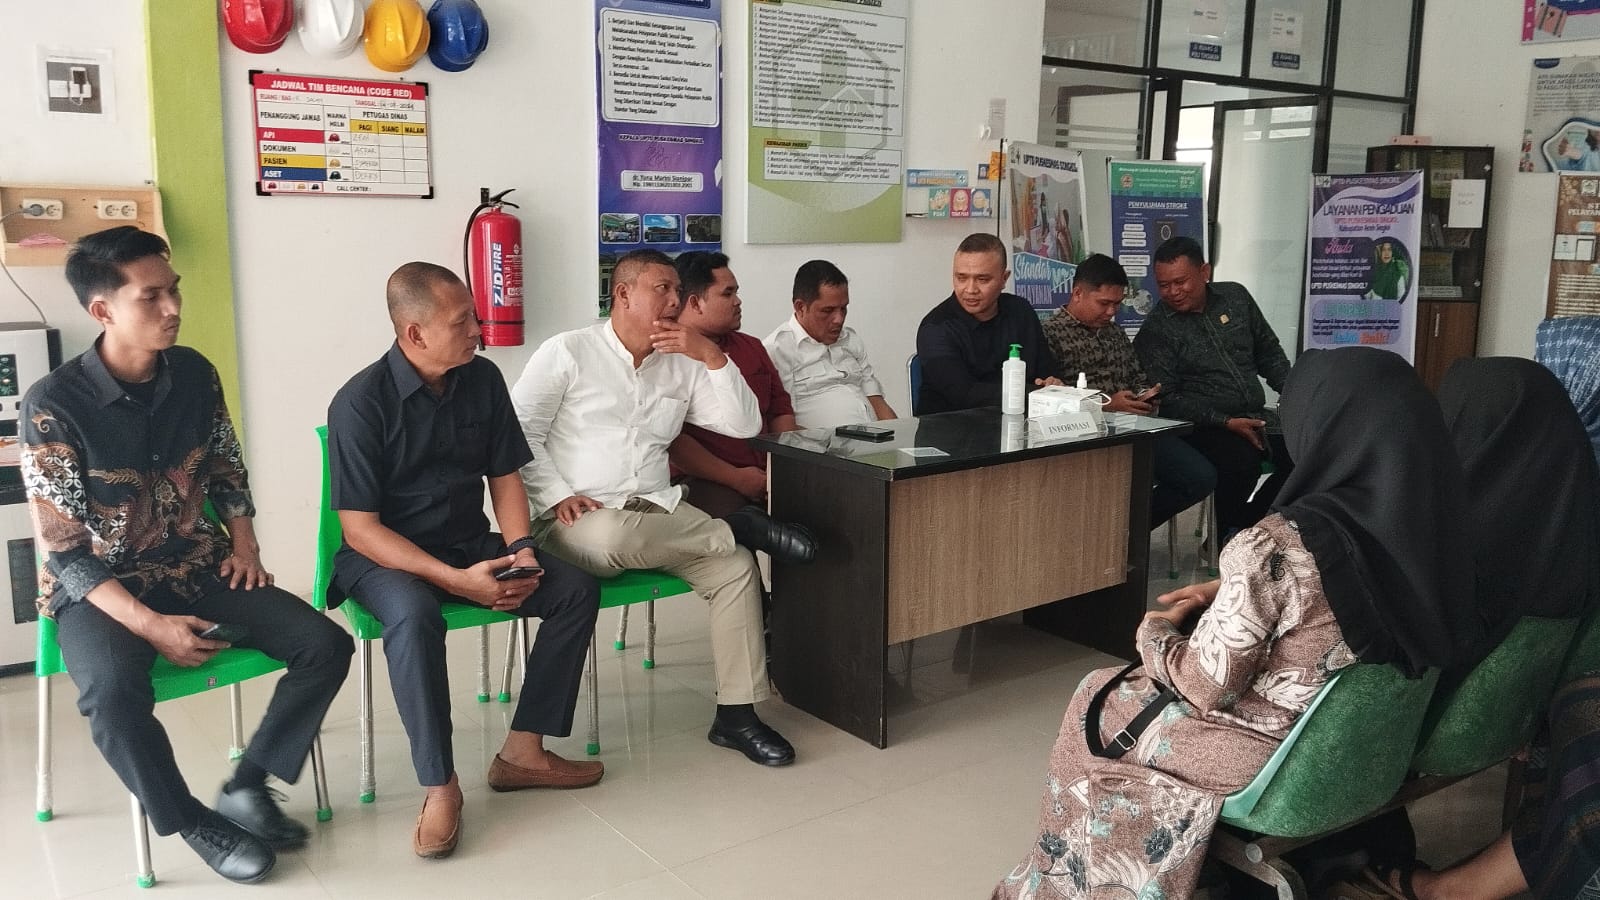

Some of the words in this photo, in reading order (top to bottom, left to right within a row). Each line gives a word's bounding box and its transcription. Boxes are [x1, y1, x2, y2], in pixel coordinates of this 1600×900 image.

[271, 80, 306, 90] JADWAL
[308, 82, 324, 91] TIM
[325, 84, 365, 94] BENCANA
[367, 87, 392, 96] (CODE
[393, 89, 412, 99] RED)
[260, 111, 300, 120] PENANGGUNG
[263, 131, 275, 139] API
[1324, 205, 1361, 216] LAYANAN
[1362, 204, 1414, 215] PENGADUAN
[1015, 254, 1050, 280] Standar
[1048, 422, 1090, 434] INFORMASI
